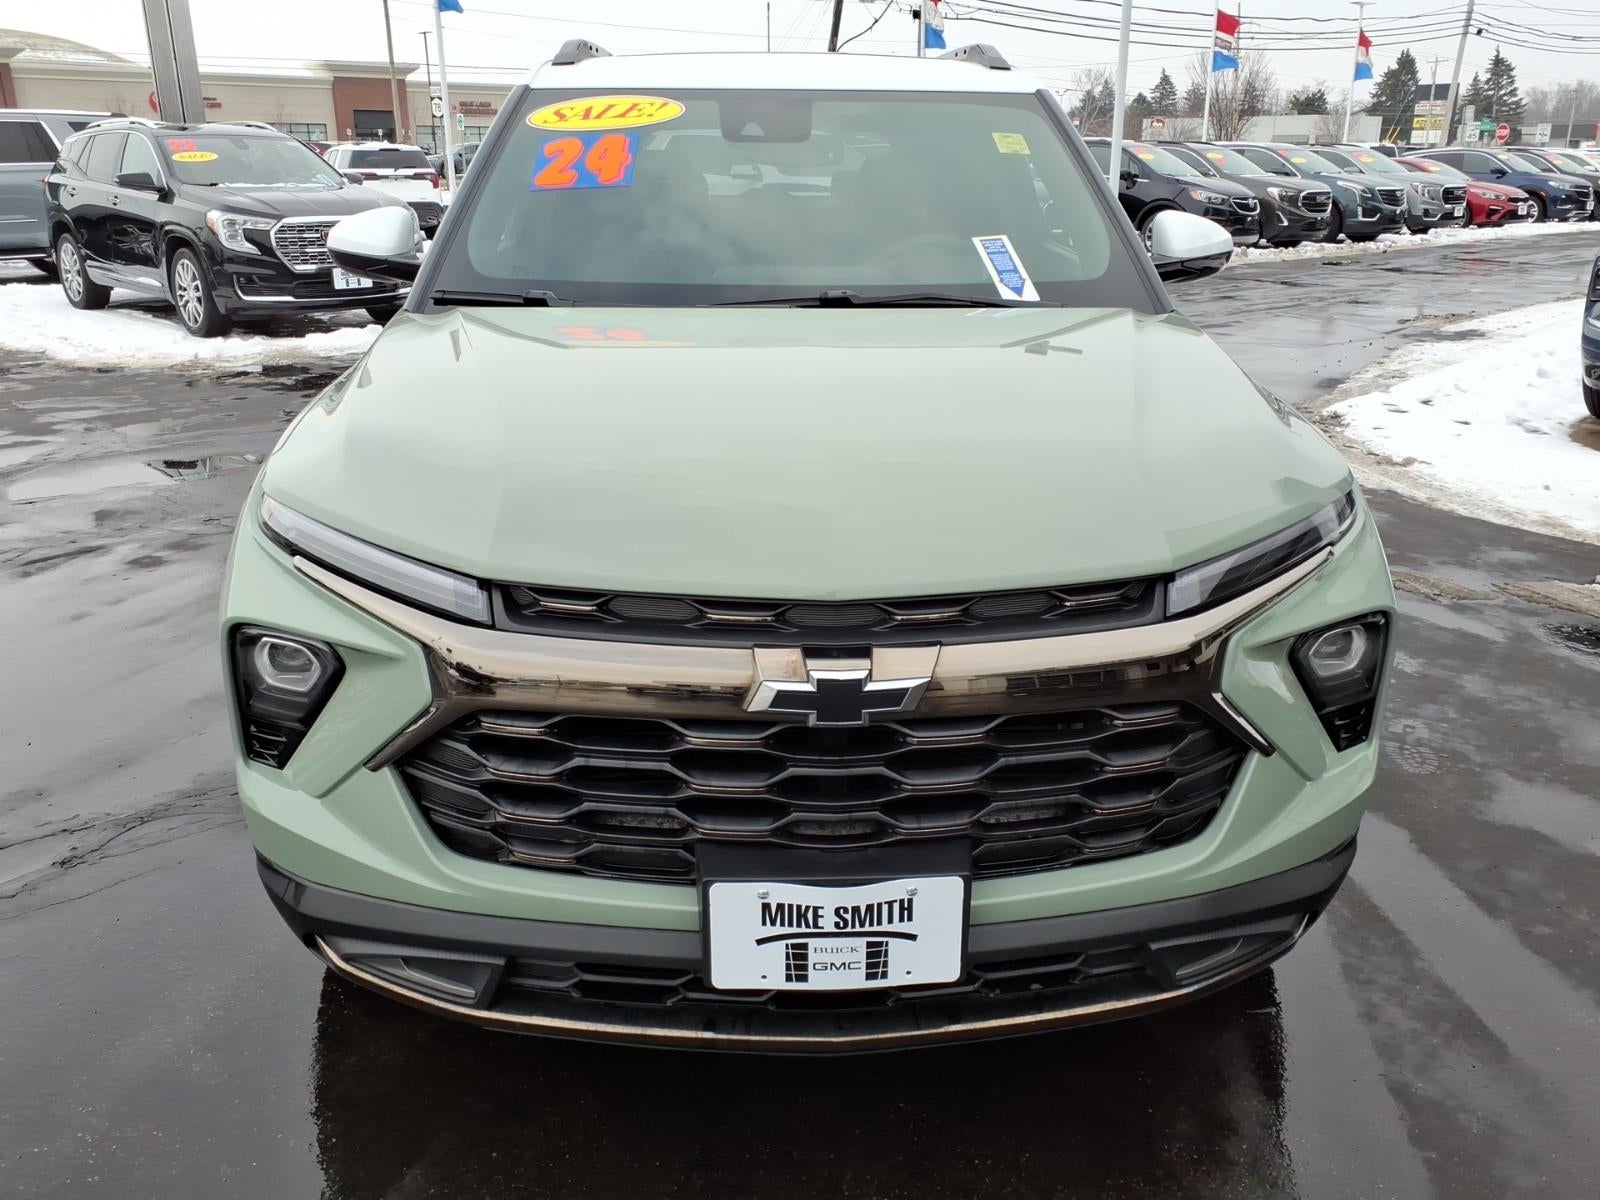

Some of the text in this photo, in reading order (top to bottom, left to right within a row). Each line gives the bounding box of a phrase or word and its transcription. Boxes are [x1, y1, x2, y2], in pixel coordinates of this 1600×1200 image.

[542, 102, 670, 124] SALE!
[534, 133, 633, 189] 24
[761, 898, 914, 931] MIKE SMITH
[813, 945, 860, 954] BUICK
[812, 960, 862, 972] GMC
